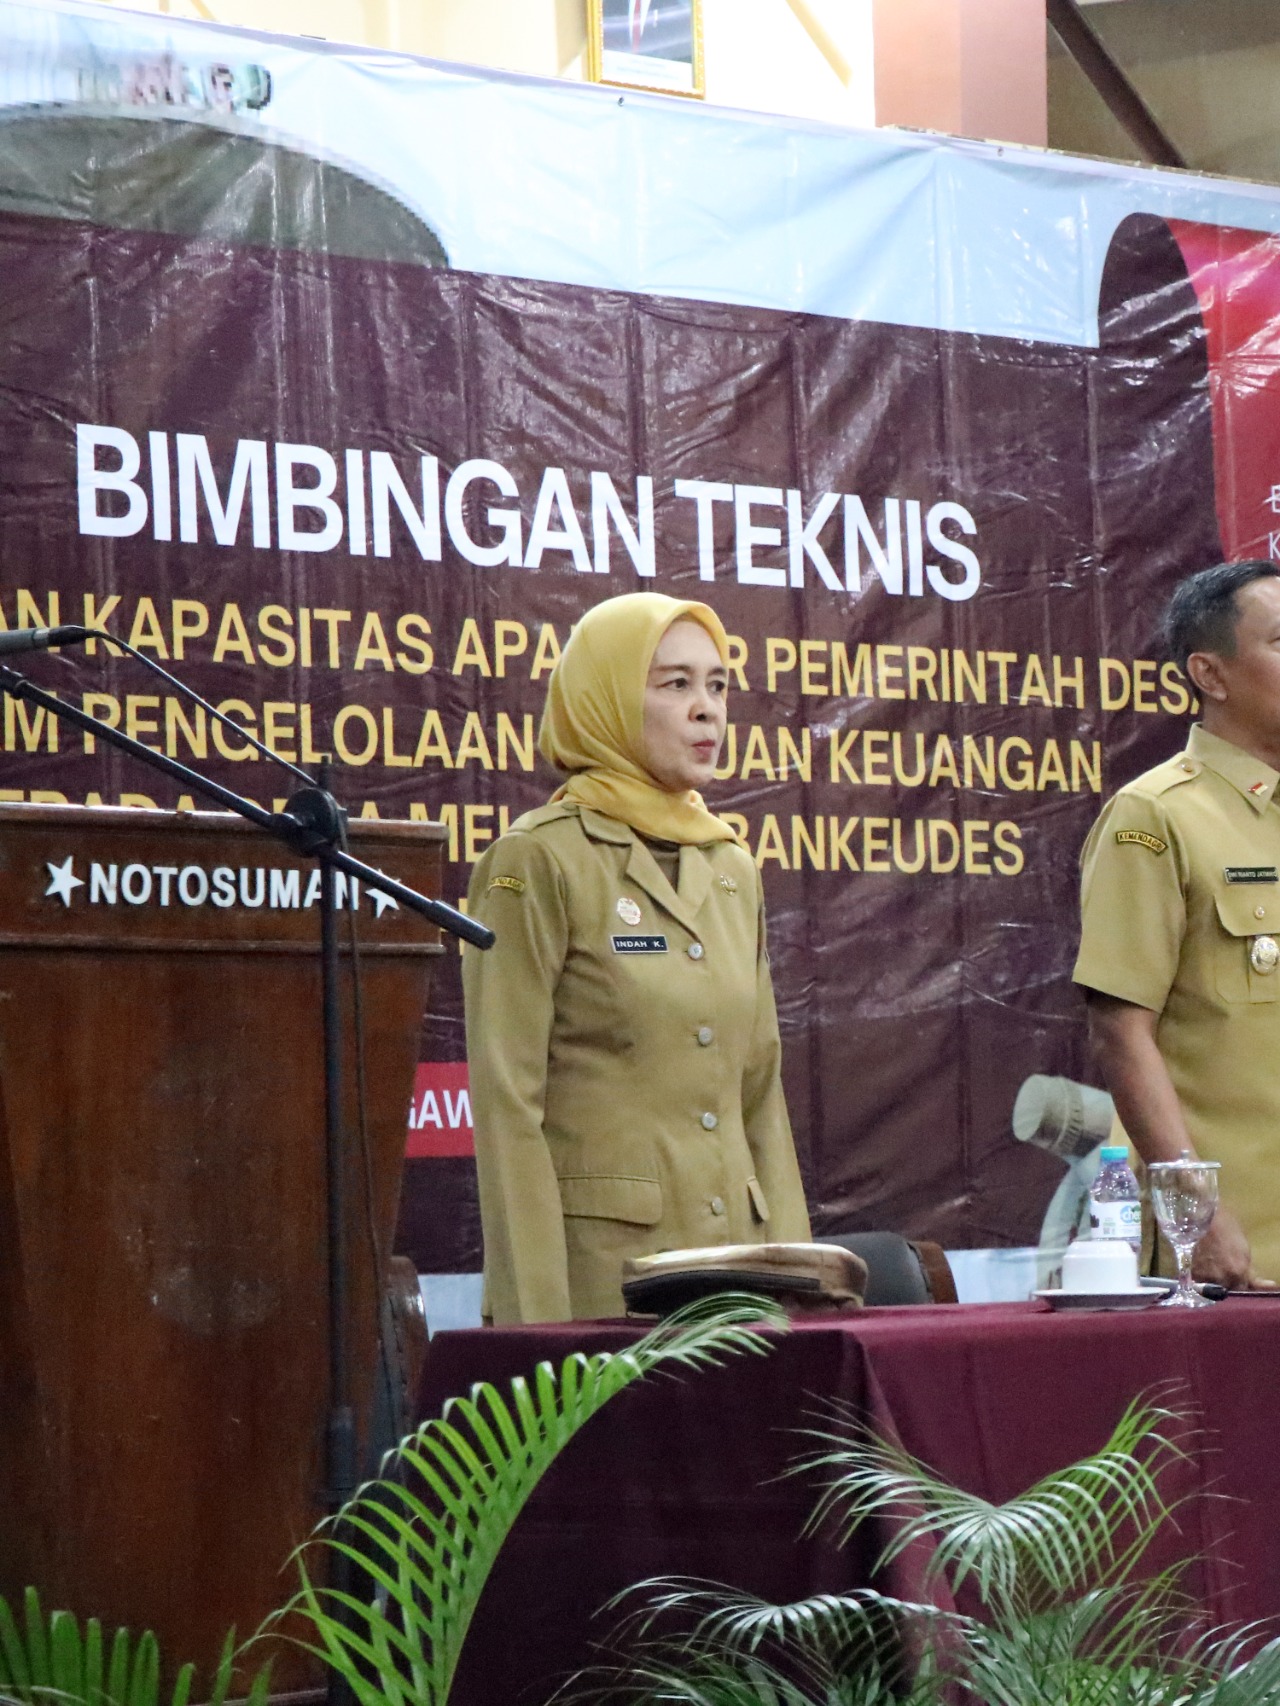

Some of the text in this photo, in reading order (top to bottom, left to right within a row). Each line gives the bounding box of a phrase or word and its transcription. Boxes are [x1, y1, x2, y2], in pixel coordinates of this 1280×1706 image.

[76, 423, 981, 601] BIMBINGAN TEKNIS
[83, 593, 434, 675] KAPASITAS
[766, 637, 1085, 710] PEMERINTAH
[1099, 658, 1200, 715] DES
[83, 692, 534, 772] PENGELOLAAN
[830, 729, 1101, 793] KEUANGAN
[615, 940, 665, 948] INDAH K.
